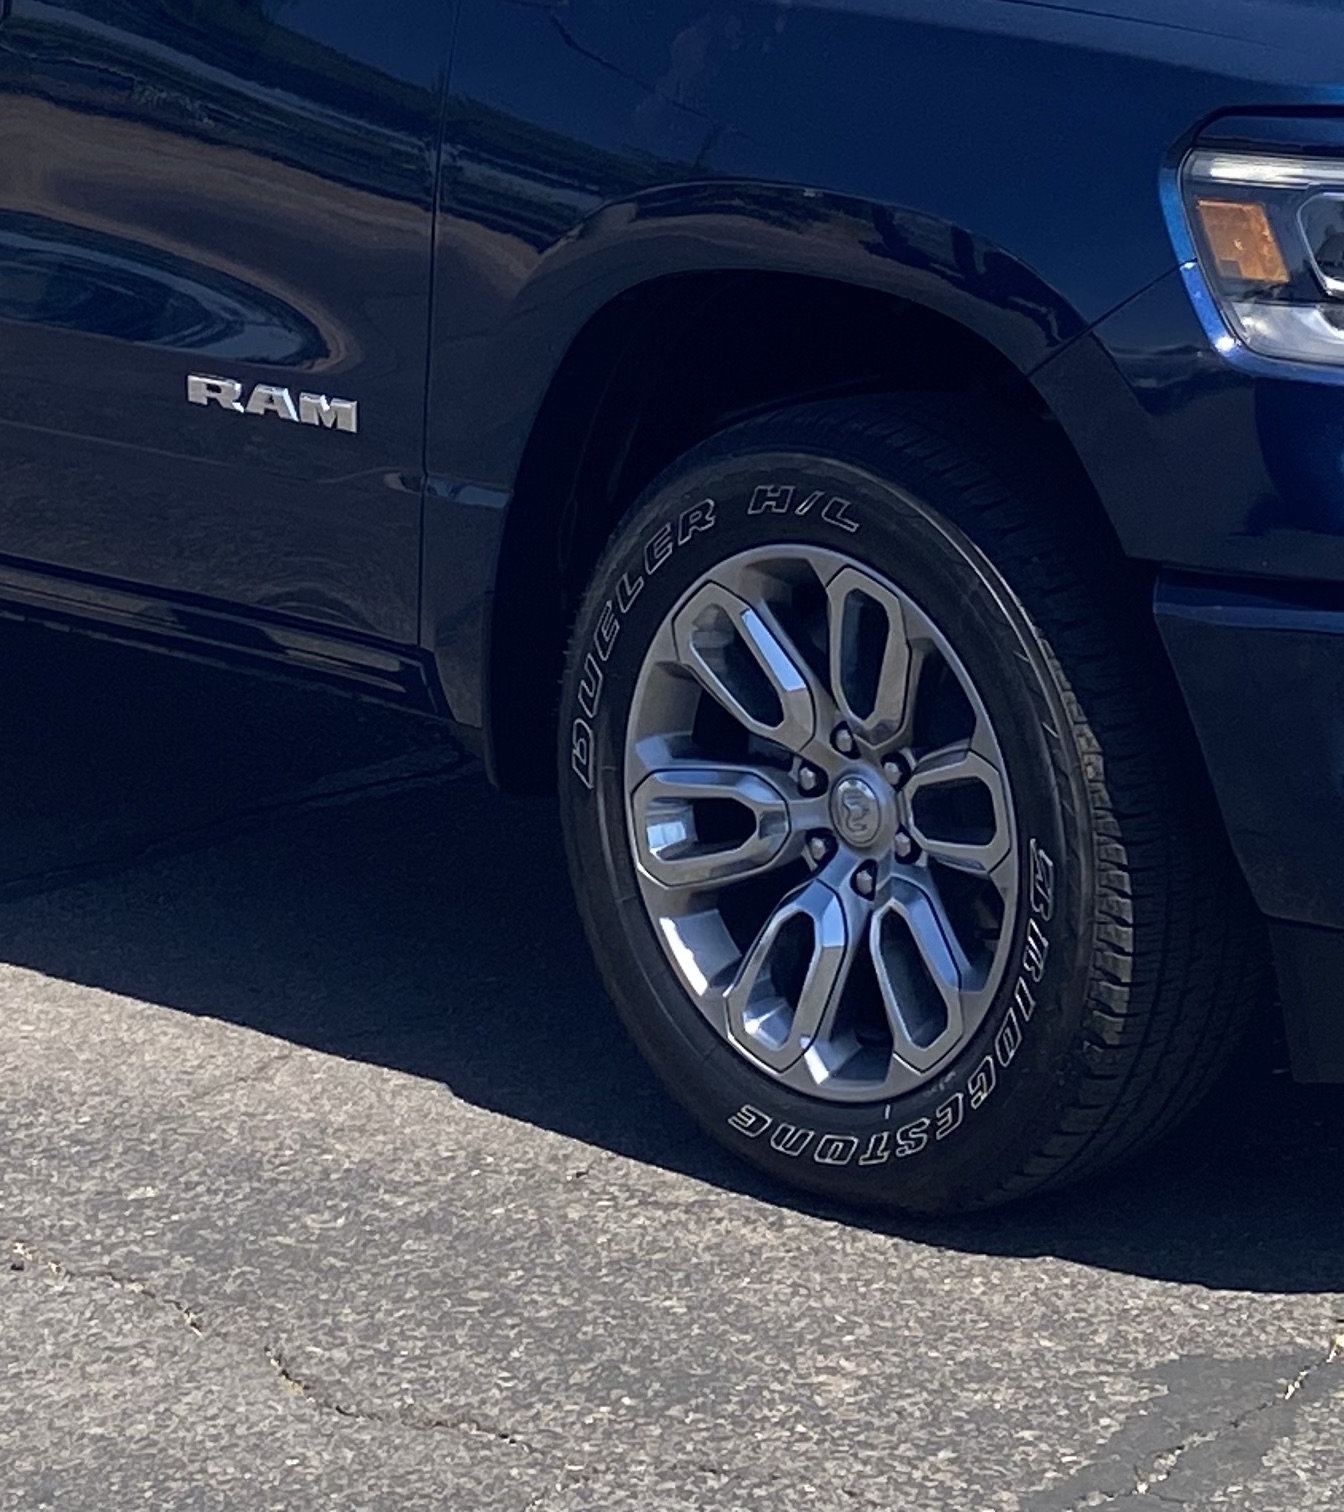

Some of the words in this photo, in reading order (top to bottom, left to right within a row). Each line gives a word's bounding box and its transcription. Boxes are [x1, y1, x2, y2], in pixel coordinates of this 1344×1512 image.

[186, 372, 358, 434] RAM
[571, 498, 716, 790] DUELER
[747, 485, 861, 534] H/L
[727, 837, 1054, 1166] BRIDGESTONE
